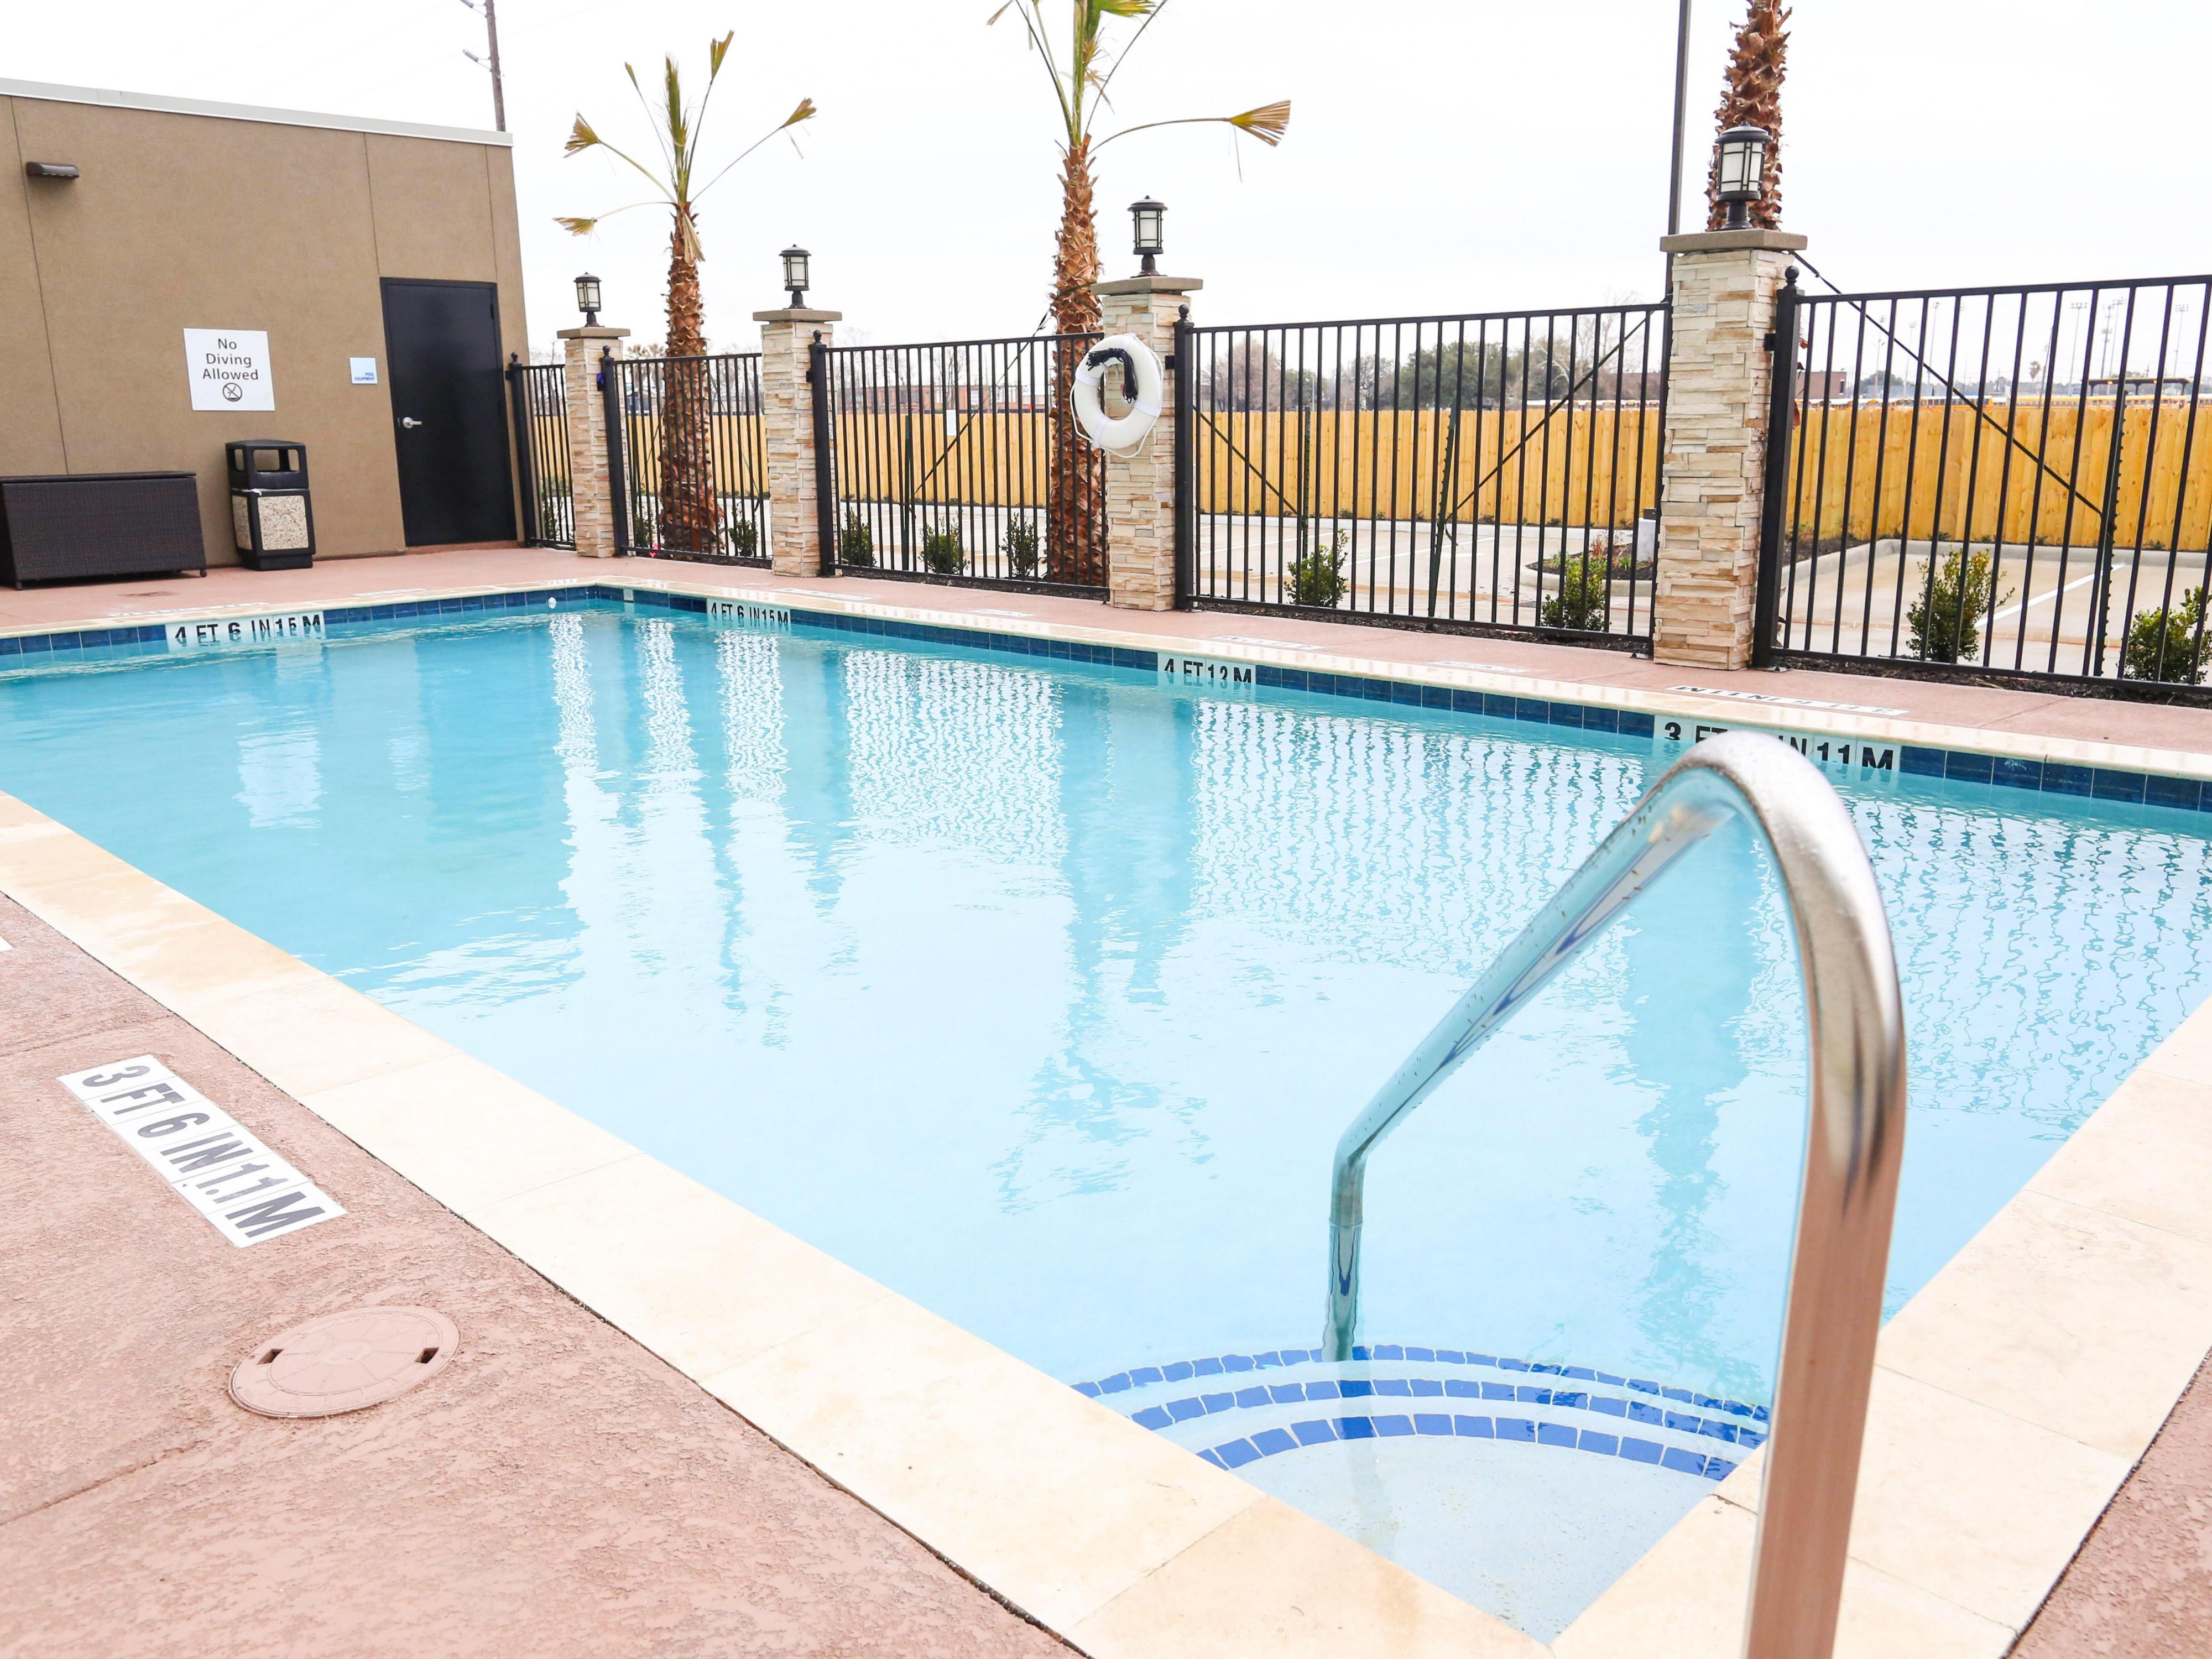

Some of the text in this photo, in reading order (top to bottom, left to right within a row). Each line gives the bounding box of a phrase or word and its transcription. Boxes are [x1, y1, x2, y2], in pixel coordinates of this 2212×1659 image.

[217, 338, 237, 349] No
[206, 353, 252, 368] Diving
[202, 368, 259, 380] Allowed
[721, 603, 733, 615] FT
[737, 605, 744, 618] 6
[778, 611, 789, 623] M
[196, 623, 218, 640] FT
[1164, 658, 1175, 672] 4
[1183, 660, 1204, 677] FT
[1234, 667, 1252, 684] M
[1664, 722, 1681, 741] 3
[1861, 747, 1894, 770] M
[82, 1065, 151, 1088] 3
[100, 1082, 186, 1115] FT
[137, 1112, 211, 1139] 6
[159, 1131, 254, 1173] IN
[224, 1191, 326, 1239] M
